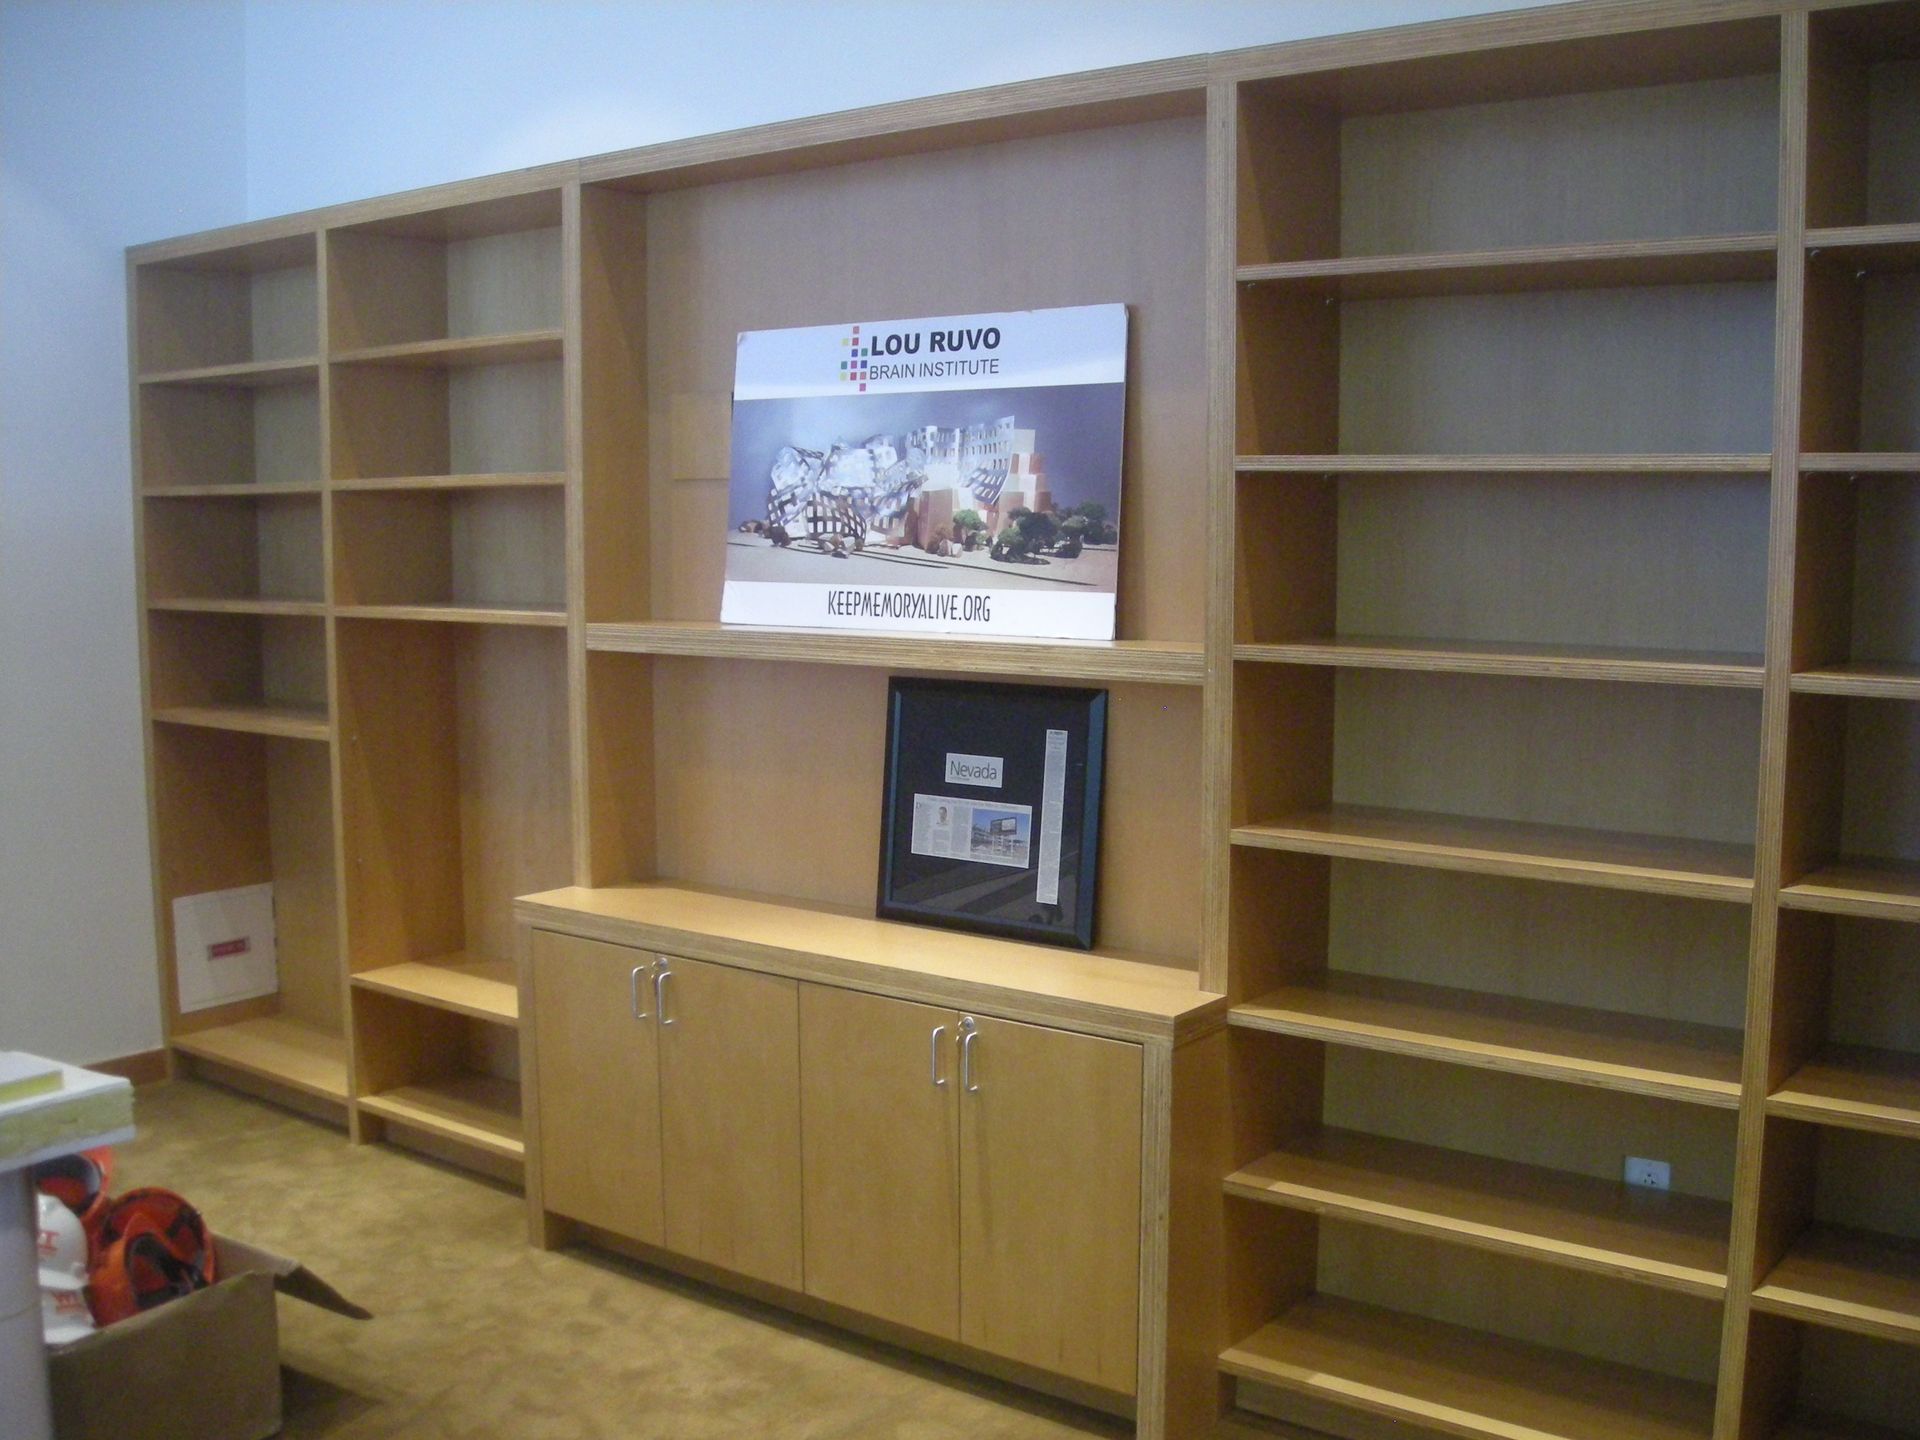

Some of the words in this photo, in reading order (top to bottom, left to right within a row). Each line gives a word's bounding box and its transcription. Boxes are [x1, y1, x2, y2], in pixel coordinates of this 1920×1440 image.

[871, 333, 921, 356] LOU
[929, 327, 1001, 353] RUVO
[869, 363, 915, 380] BRAIN
[919, 358, 1000, 378] INSTITUTE
[828, 590, 991, 622] KEEPMEMORYALIVE.ORG
[949, 760, 998, 780] Nevada
